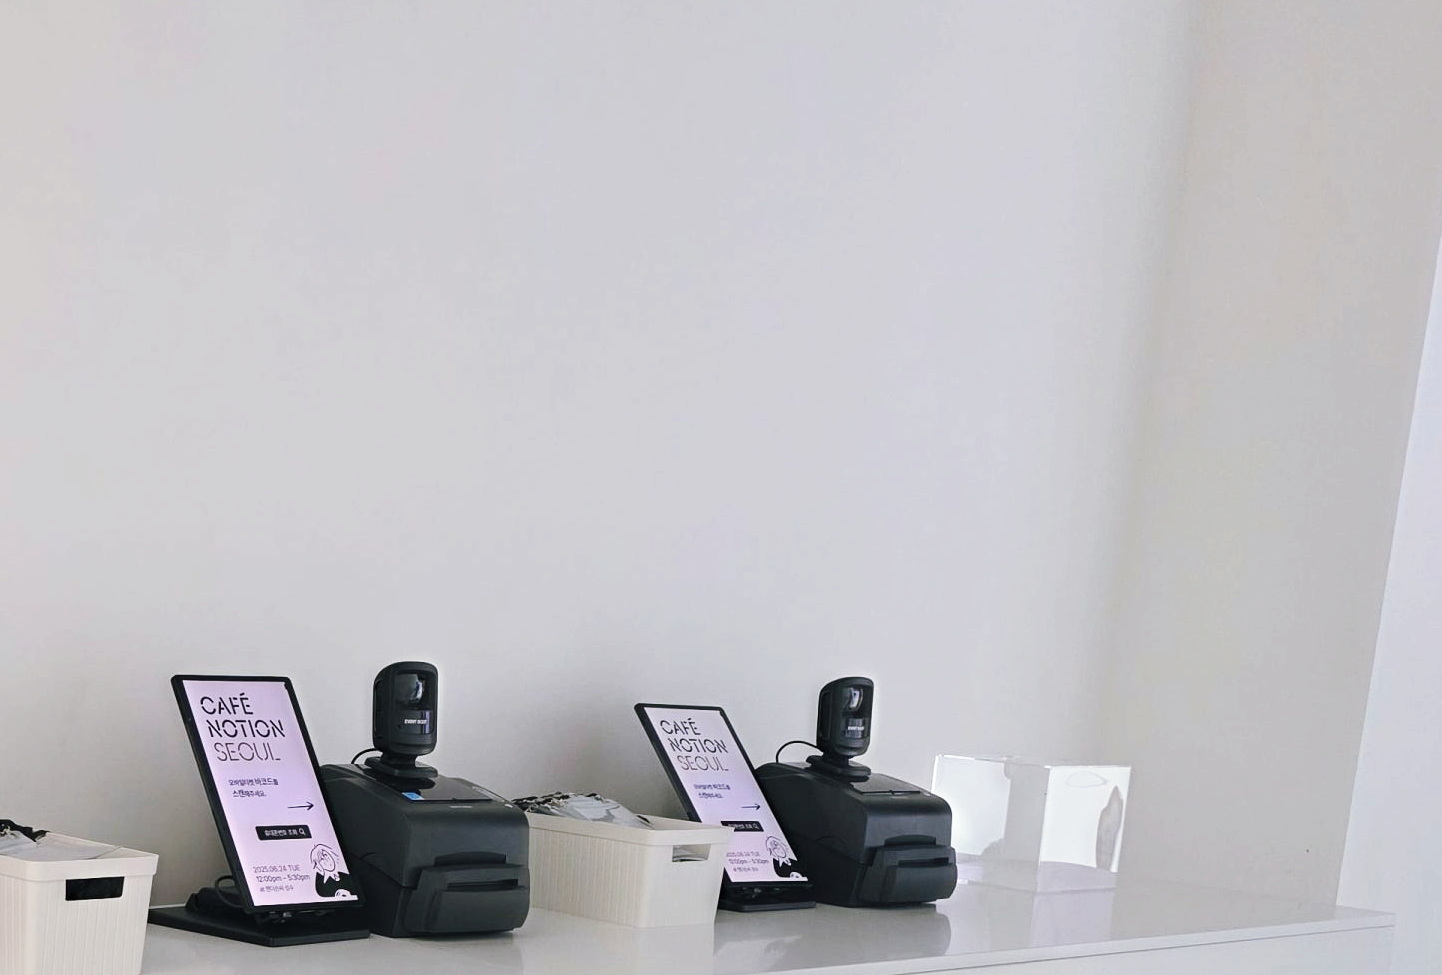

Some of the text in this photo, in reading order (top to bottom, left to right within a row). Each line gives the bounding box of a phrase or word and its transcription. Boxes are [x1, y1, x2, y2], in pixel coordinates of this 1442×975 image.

[200, 692, 254, 715] CAFÉ
[206, 719, 286, 738] NOTION
[660, 717, 701, 735] CAFÉ
[213, 741, 281, 762] SEOUL
[667, 738, 729, 753] NOTION
[676, 755, 729, 771] SEOUL
